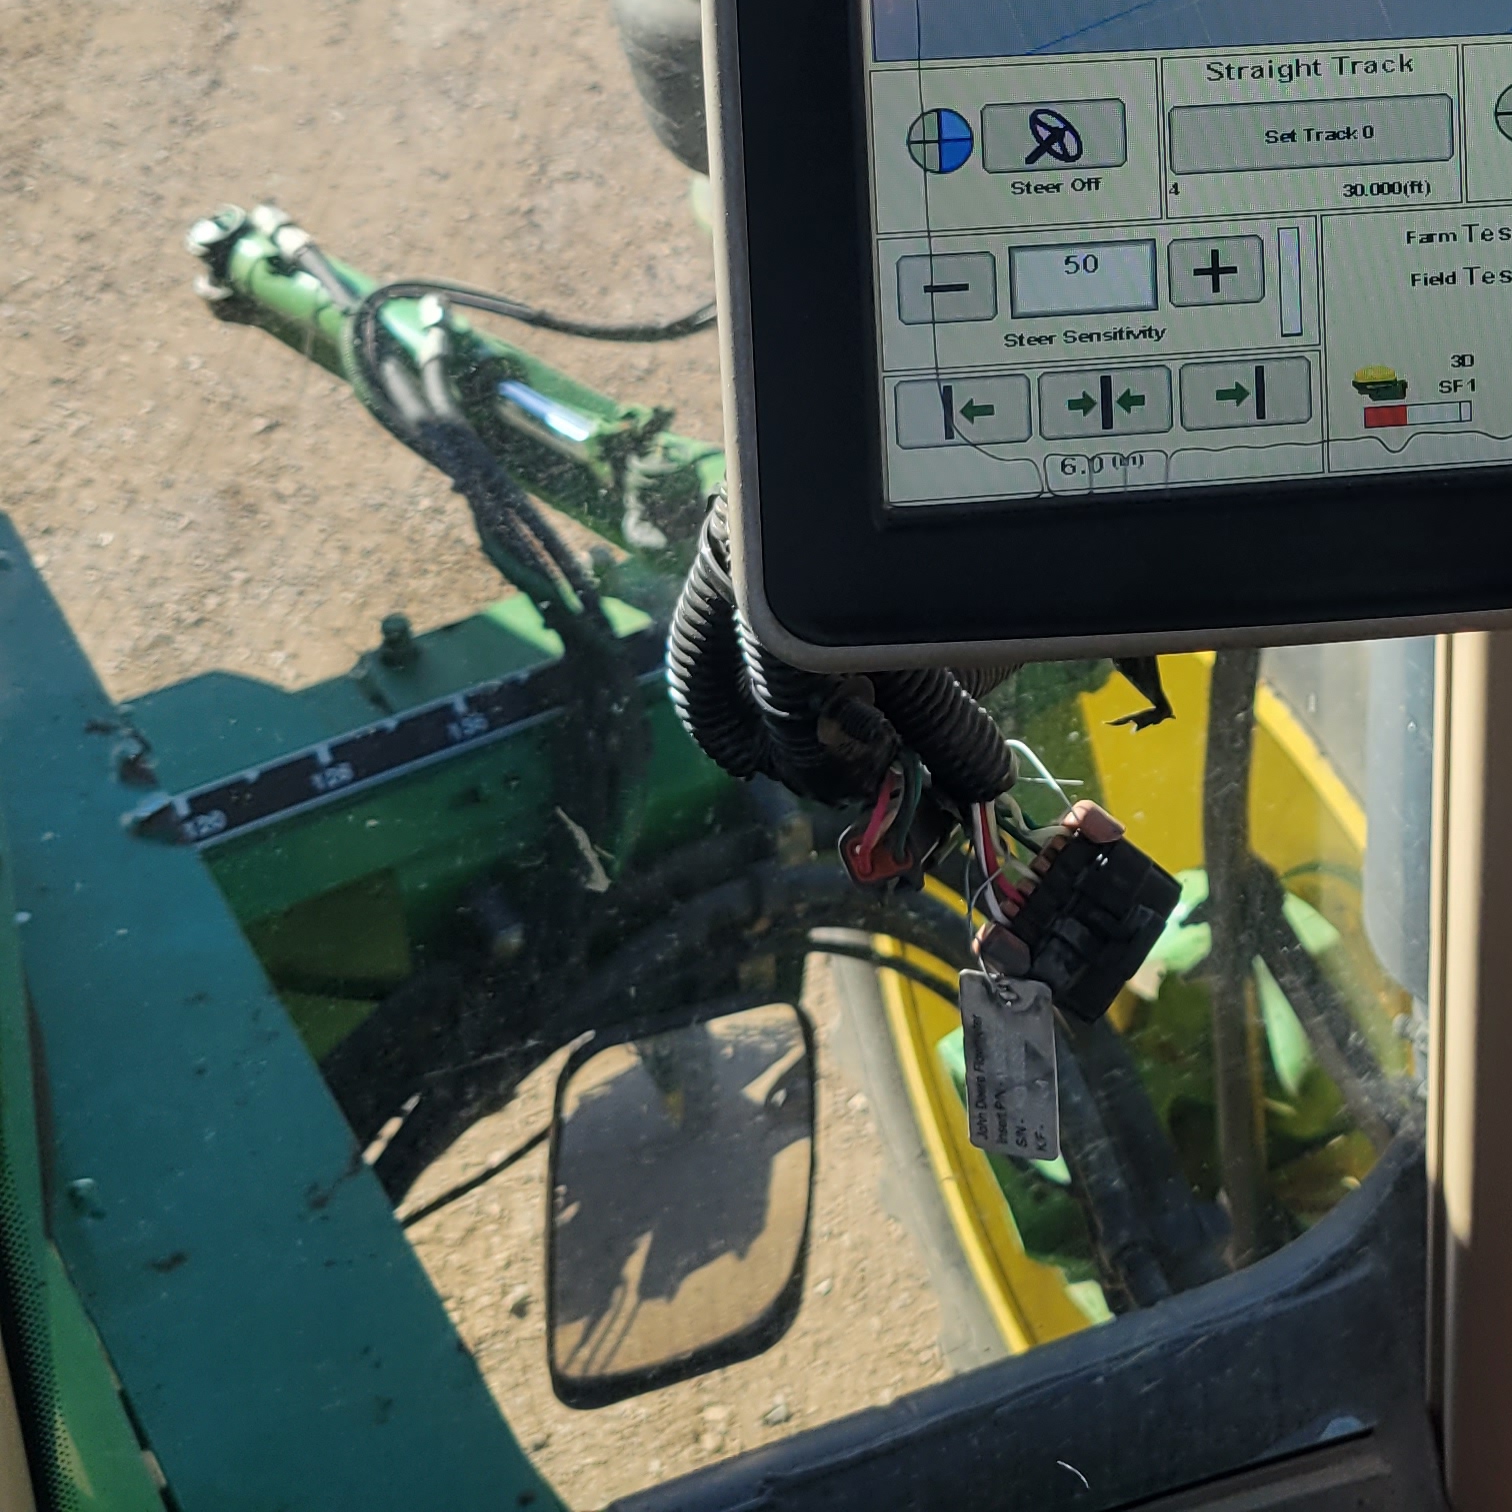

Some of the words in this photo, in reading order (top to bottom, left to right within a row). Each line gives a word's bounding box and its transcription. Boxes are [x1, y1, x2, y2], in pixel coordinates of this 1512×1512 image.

[1205, 59, 1323, 83] Straight
[1331, 54, 1414, 77] Track
[1264, 129, 1297, 144] Set
[1303, 128, 1358, 142] Track
[1011, 180, 1063, 195] Steer
[1071, 176, 1102, 192] Off
[1169, 183, 1180, 196] 4
[1406, 229, 1457, 244] Farm
[1064, 255, 1099, 275] 50
[1411, 272, 1457, 287] Field
[1004, 332, 1056, 348] Steer
[1063, 326, 1167, 345] Sensitivity
[1450, 354, 1475, 367] 3D
[1438, 379, 1477, 393] SF1
[1061, 456, 1104, 475] 6.0
[976, 1076, 987, 1109] Deere
[978, 1112, 988, 1140] John
